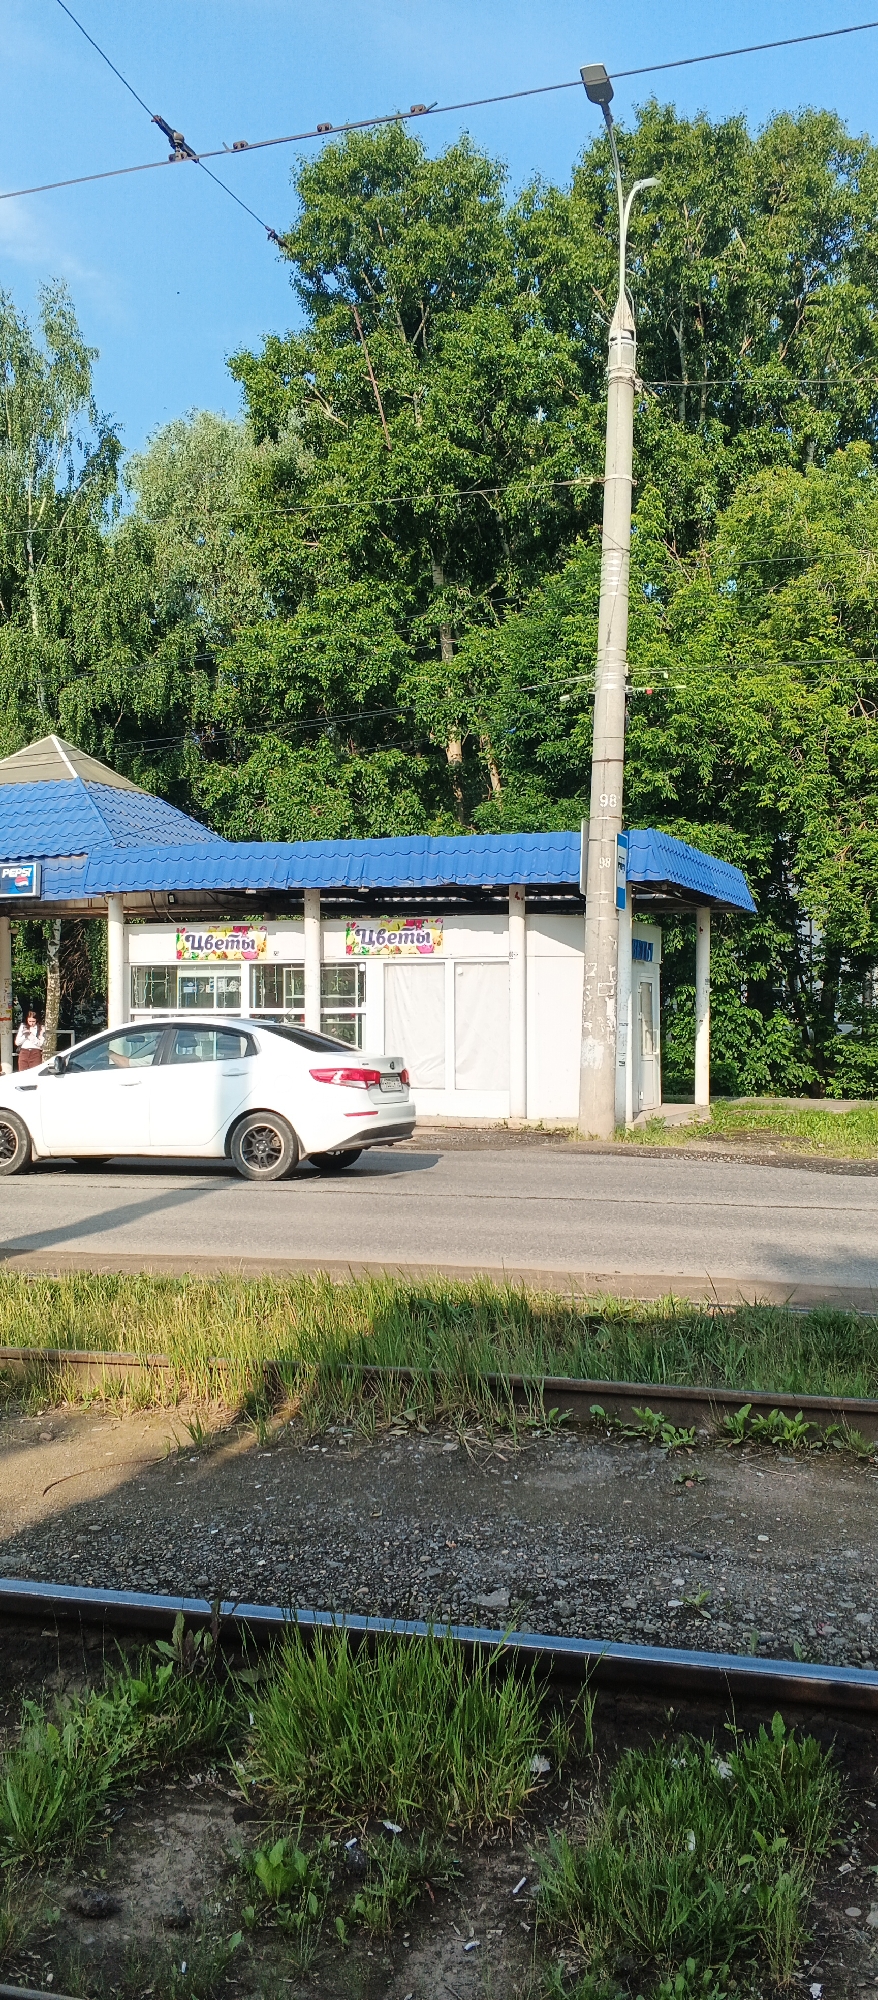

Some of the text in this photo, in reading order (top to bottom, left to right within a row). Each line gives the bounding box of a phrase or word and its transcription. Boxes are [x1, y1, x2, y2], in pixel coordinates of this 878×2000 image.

[599, 793, 617, 808] 98
[599, 857, 611, 869] 98
[1, 867, 33, 878] PEPSI
[184, 933, 256, 952] Цветы
[354, 927, 431, 947] Цветы
